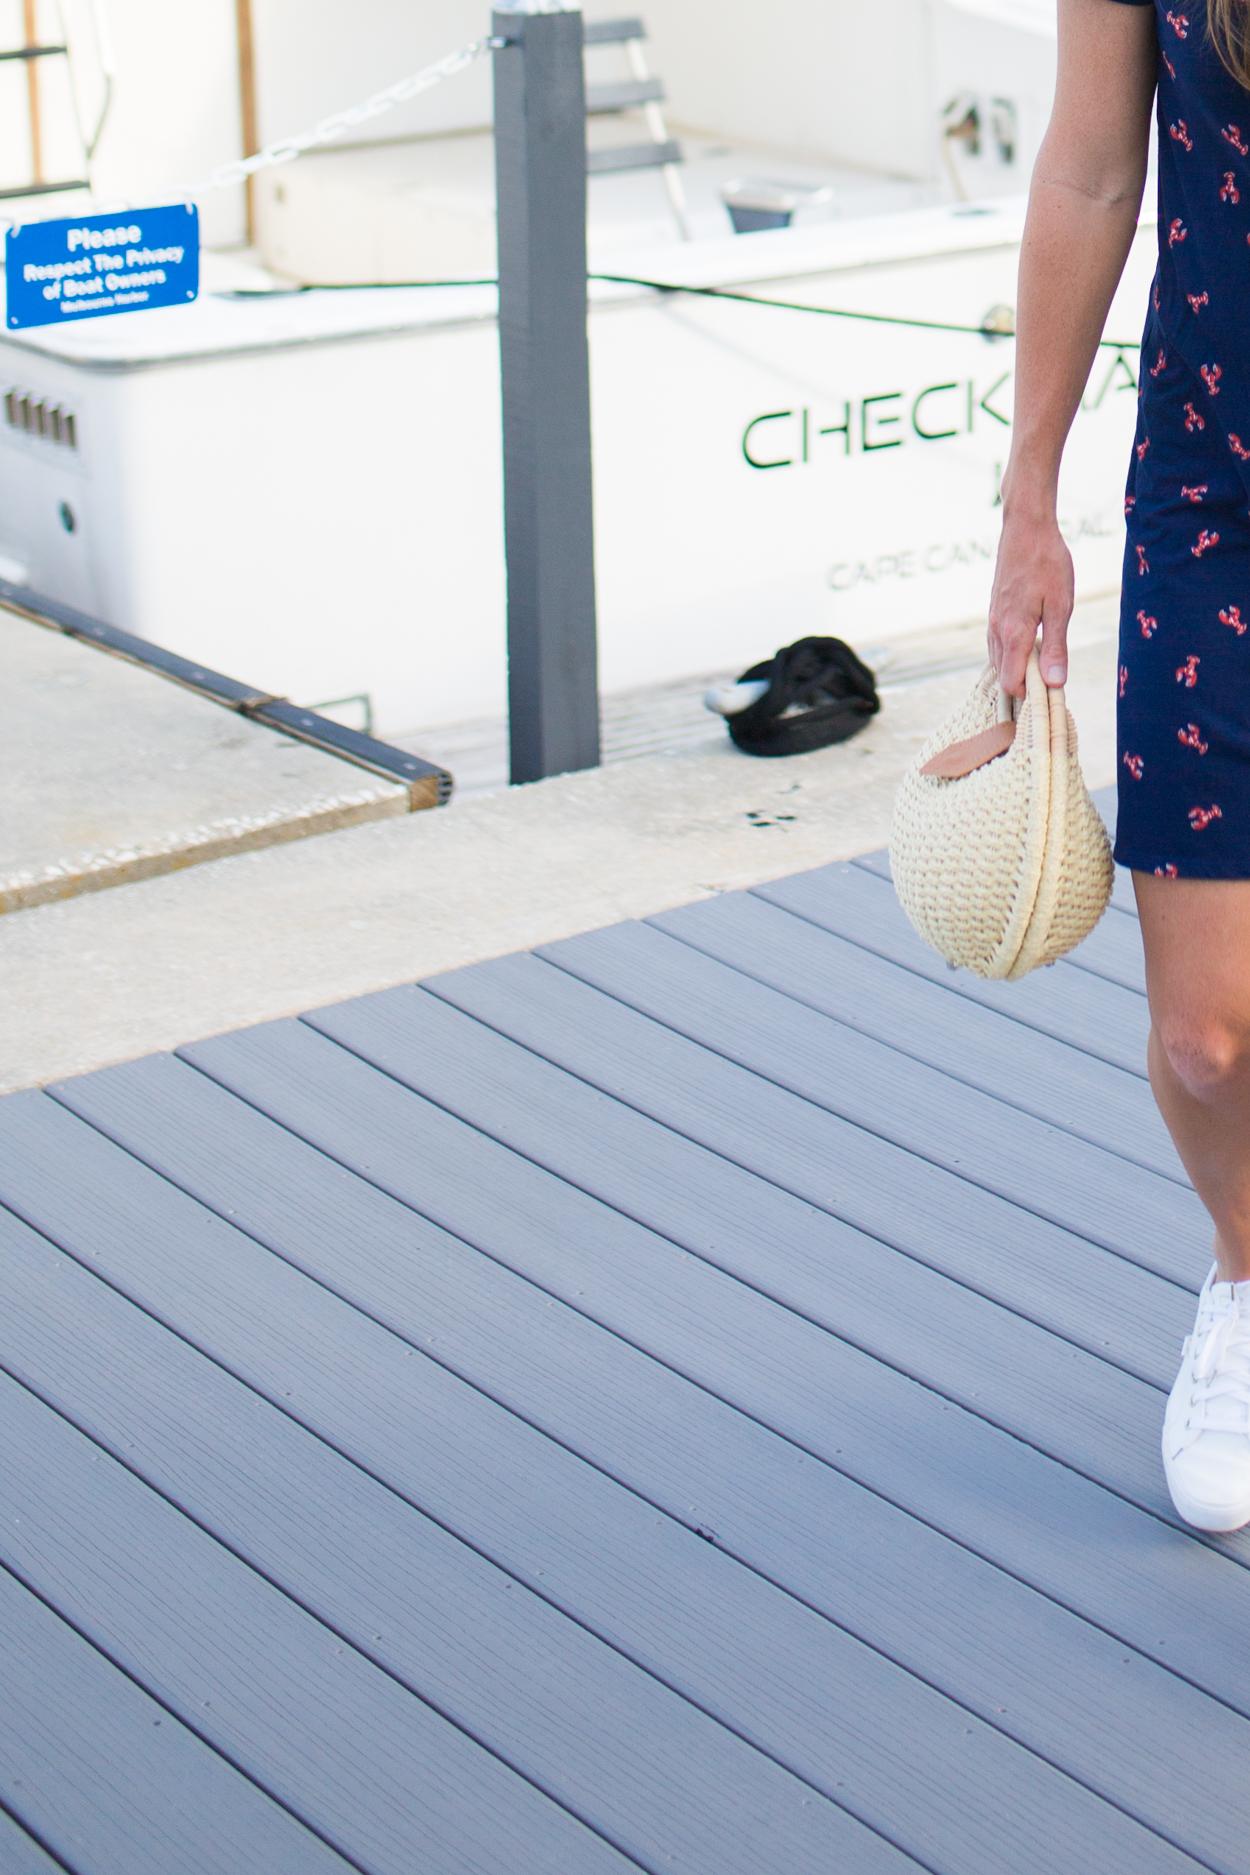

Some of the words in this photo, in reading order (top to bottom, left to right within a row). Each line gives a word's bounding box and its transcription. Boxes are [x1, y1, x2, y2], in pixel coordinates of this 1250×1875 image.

[67, 225, 142, 252] Please
[23, 257, 92, 282] Respect
[93, 253, 124, 272] The
[126, 245, 184, 267] Privacy
[42, 280, 61, 300] of
[63, 276, 104, 297] Boat
[105, 269, 166, 291] Owners
[827, 550, 915, 591] CAPE
